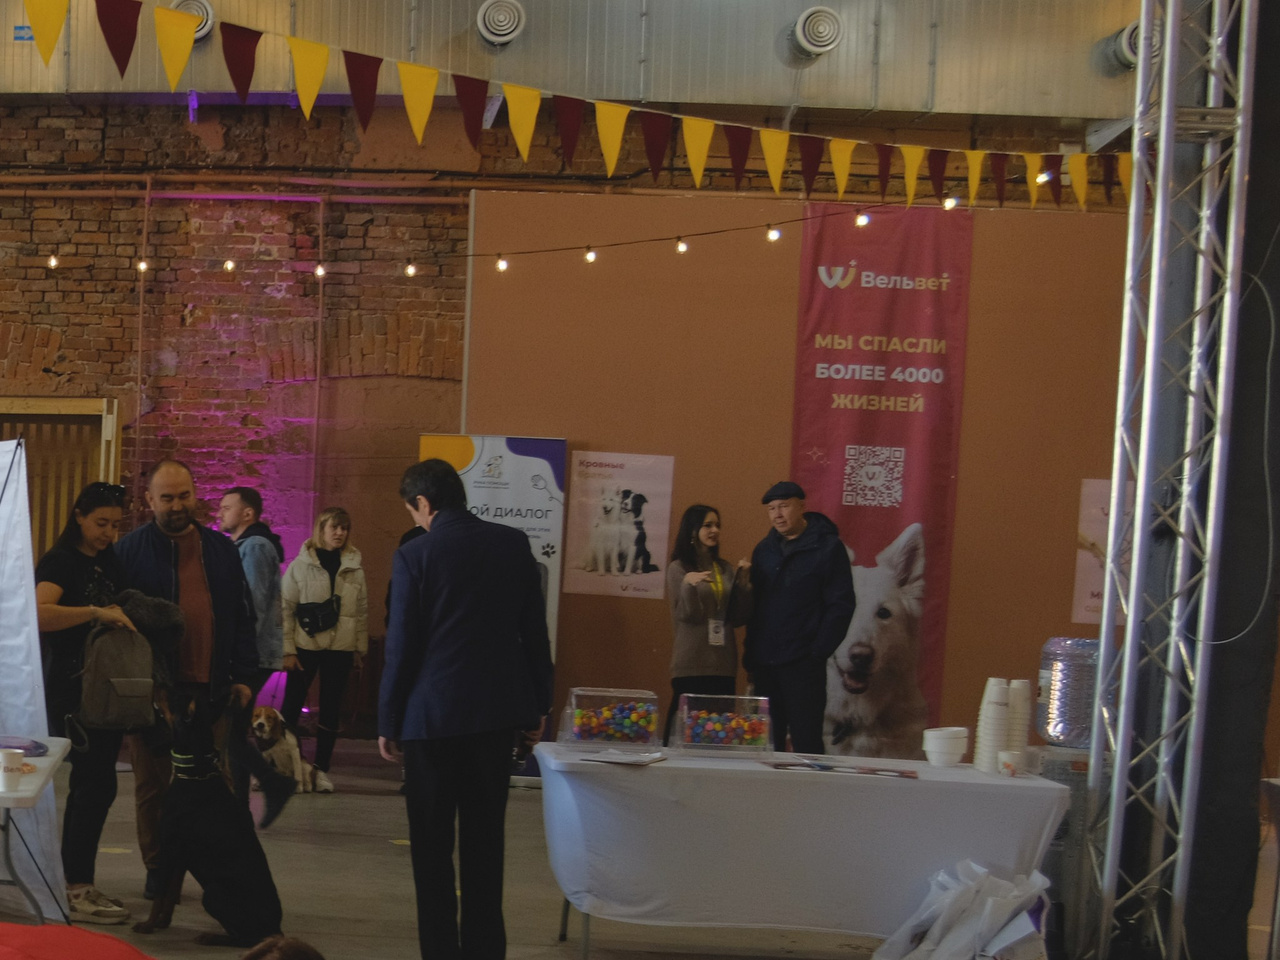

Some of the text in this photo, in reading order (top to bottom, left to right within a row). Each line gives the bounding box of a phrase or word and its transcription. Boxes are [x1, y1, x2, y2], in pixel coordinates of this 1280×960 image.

[861, 272, 951, 291] Вельвет
[814, 334, 947, 354] МЫ СПАСЛИ
[815, 363, 944, 384] БОЛЕЕ 4000
[831, 393, 925, 413] ЖИЗНЕЙ
[469, 503, 553, 520] ОЙ ДИАЛОГ
